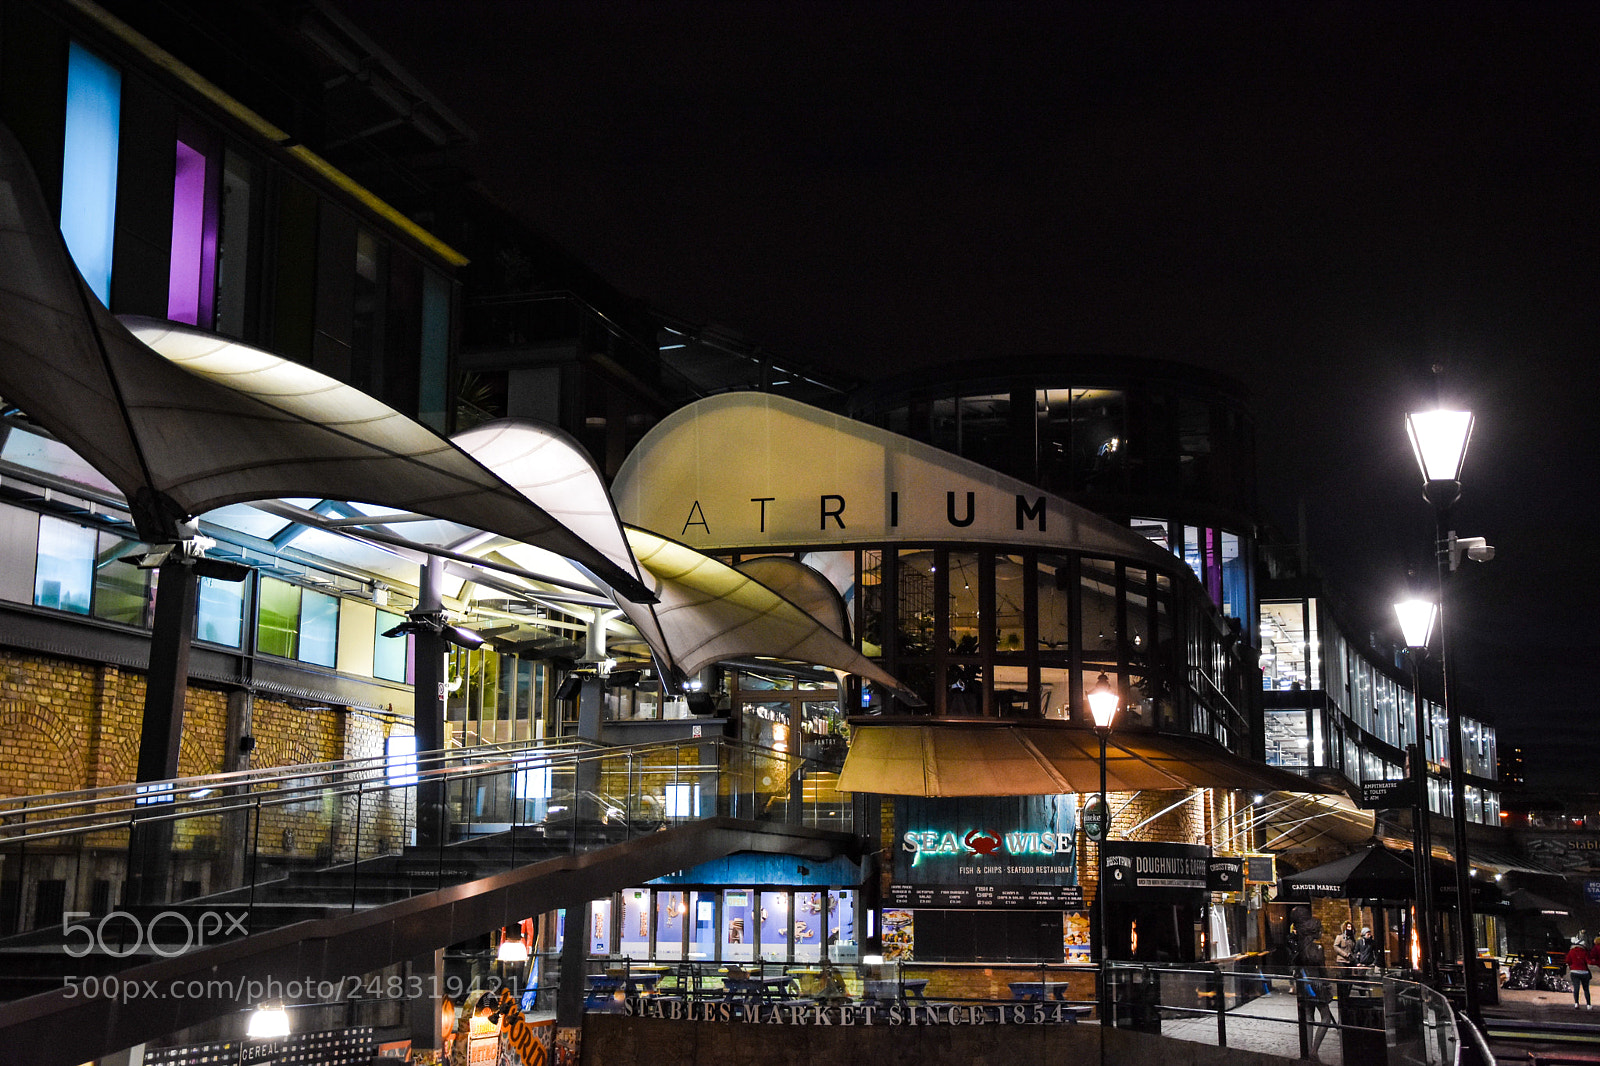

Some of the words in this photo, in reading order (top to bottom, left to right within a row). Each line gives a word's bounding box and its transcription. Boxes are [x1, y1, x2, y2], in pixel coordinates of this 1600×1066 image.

[682, 492, 1046, 535] ATRIUM
[902, 831, 959, 854] SEA
[1005, 832, 1073, 854] WISE
[1568, 840, 1600, 849] Stabl
[959, 866, 974, 874] FISH
[976, 866, 981, 874] &
[984, 866, 1002, 874] CHIPS
[1007, 866, 1034, 874] SEAFOOD
[1036, 866, 1073, 874] RESTAURANT
[1136, 856, 1184, 874] DOUGHNUTS
[1190, 860, 1206, 876] COFFEE
[1317, 884, 1341, 892] MARKET
[624, 997, 731, 1023] STABLES
[742, 1003, 878, 1026] MARKET
[889, 1004, 985, 1026] SINCE
[999, 1002, 1064, 1025] 1854
[242, 1041, 279, 1061] CEREAL
